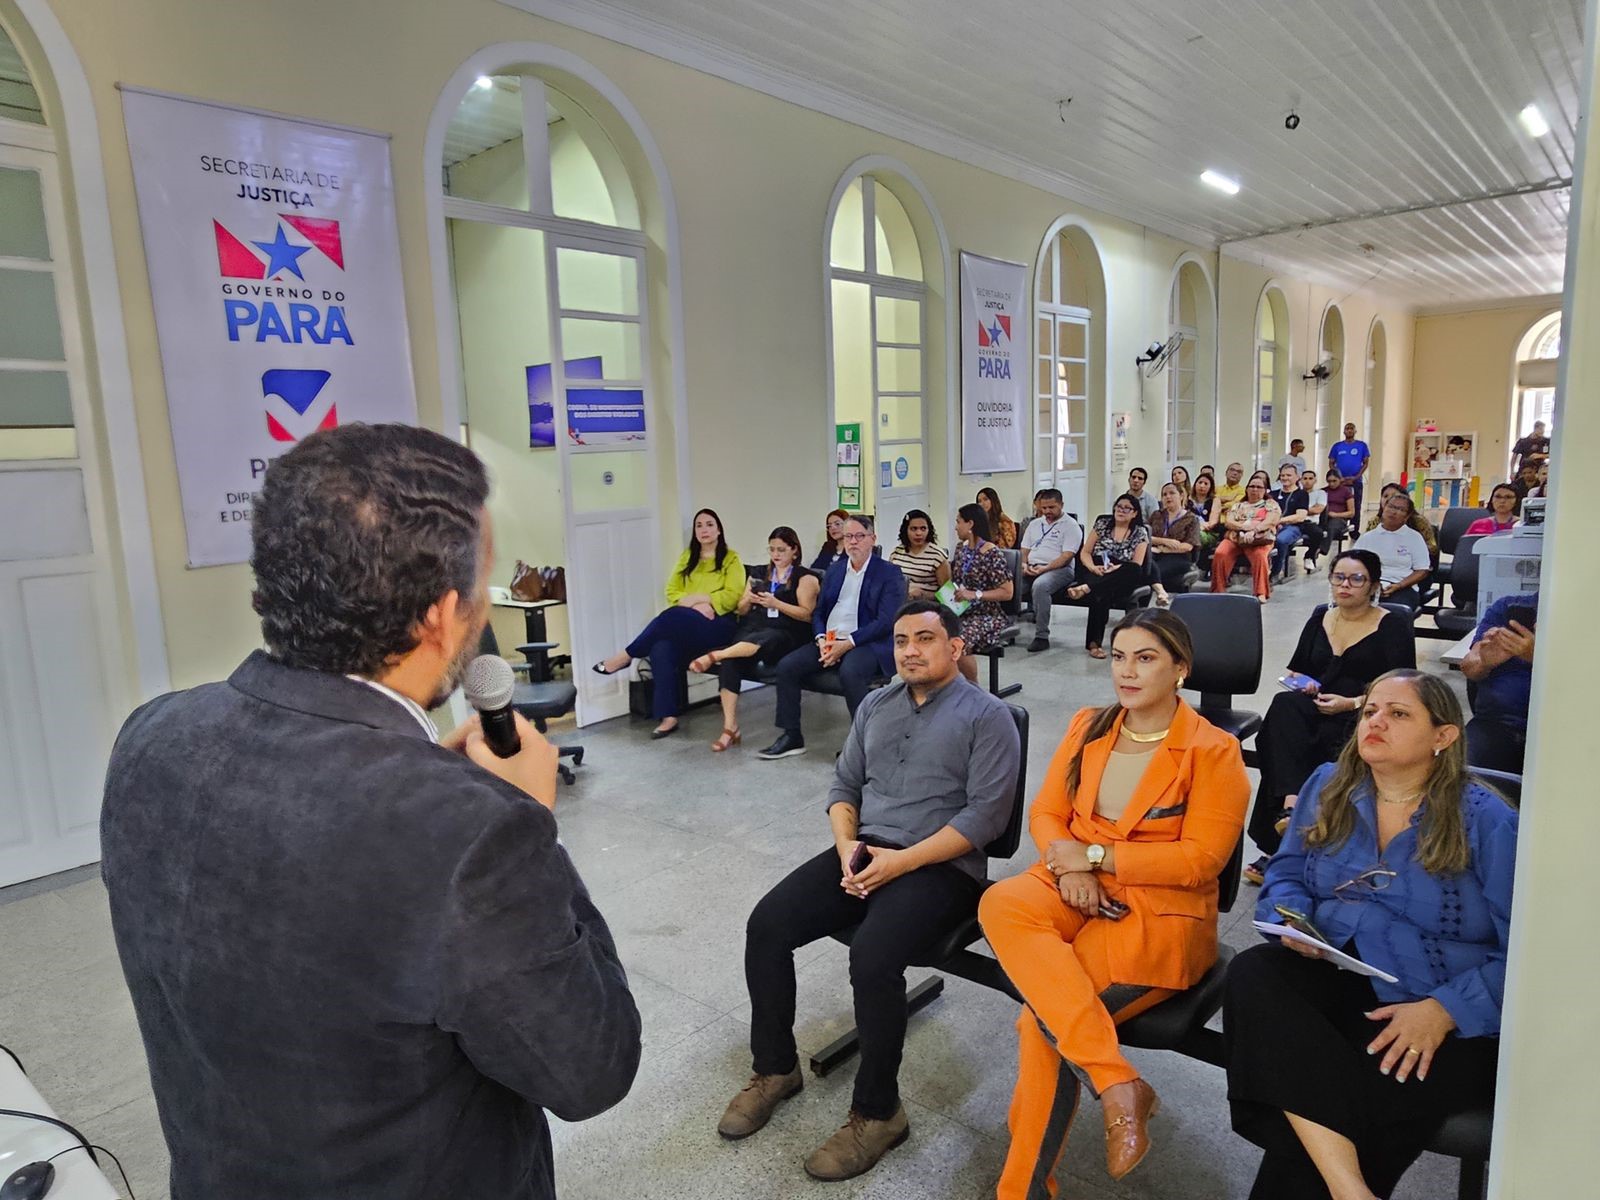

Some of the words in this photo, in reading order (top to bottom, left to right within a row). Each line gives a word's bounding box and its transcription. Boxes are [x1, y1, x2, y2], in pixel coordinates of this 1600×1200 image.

[200, 155, 313, 186] SECRETARIA
[316, 173, 341, 190] DE
[236, 184, 314, 209] JUSTIÇA
[222, 283, 313, 299] GOVERNO
[322, 290, 345, 301] DO
[977, 401, 1012, 412] OUVIDORIA
[977, 417, 986, 427] DE
[987, 417, 1012, 428] JUSTIÇA
